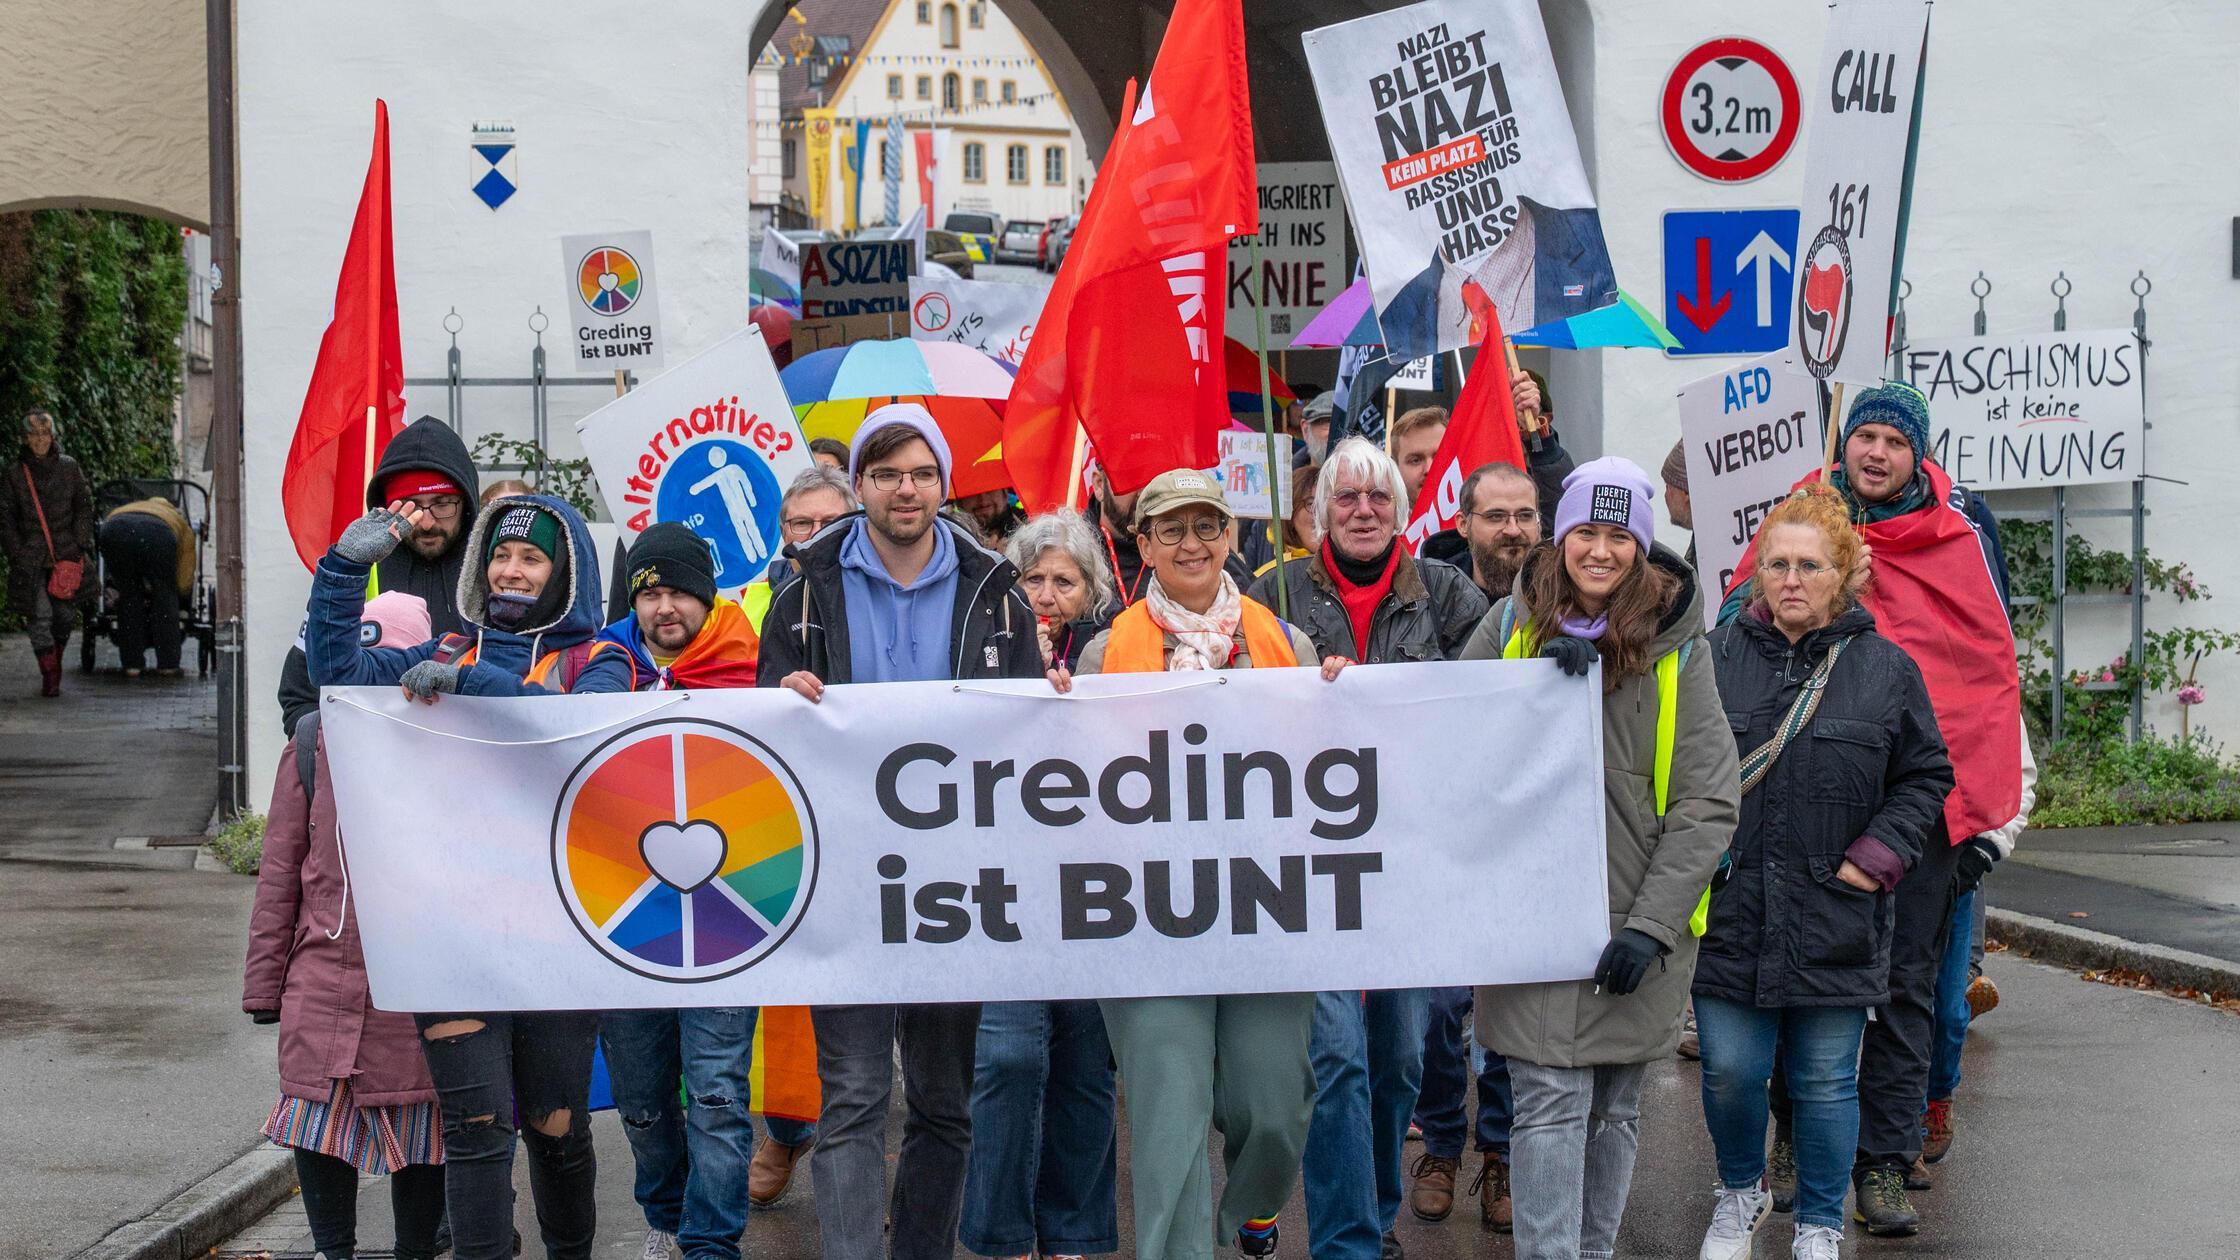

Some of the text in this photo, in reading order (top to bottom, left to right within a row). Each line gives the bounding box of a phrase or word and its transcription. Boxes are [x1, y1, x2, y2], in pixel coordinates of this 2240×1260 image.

[1397, 23, 1450, 62] NAZI
[1369, 30, 1487, 112] BLEIBT
[1831, 49, 1897, 114] CALL
[1375, 62, 1513, 164] NAZI
[1477, 117, 1520, 151] FÜR
[1390, 140, 1478, 184] KEIN PLATZ
[1405, 142, 1522, 211] RASSISMUS
[1434, 177, 1504, 230] UND
[1829, 182, 1870, 239] 161
[1291, 221, 1326, 246] INS
[1442, 205, 1518, 264] HASS
[1804, 230, 1852, 282] ANTIFASCHISTISCHE
[1228, 258, 1325, 309] KNIE
[579, 323, 652, 341] Greding
[580, 342, 653, 359] ist BUNT
[1724, 366, 1772, 415] AFD
[1808, 359, 1834, 378] AKTION
[1907, 341, 2132, 402] FASCHISMUS
[1986, 394, 2081, 424] ist keine
[623, 395, 794, 533] Alternative?
[1704, 410, 1807, 477] VERBOT
[1593, 508, 1627, 523] FCKAfDÉ
[1595, 496, 1628, 512] ÉGALITÉ
[1597, 486, 1629, 500] LIBERTÉ
[1731, 493, 1791, 546] JET
[875, 723, 1379, 841] Greding
[876, 851, 1384, 944] ist BUNT
